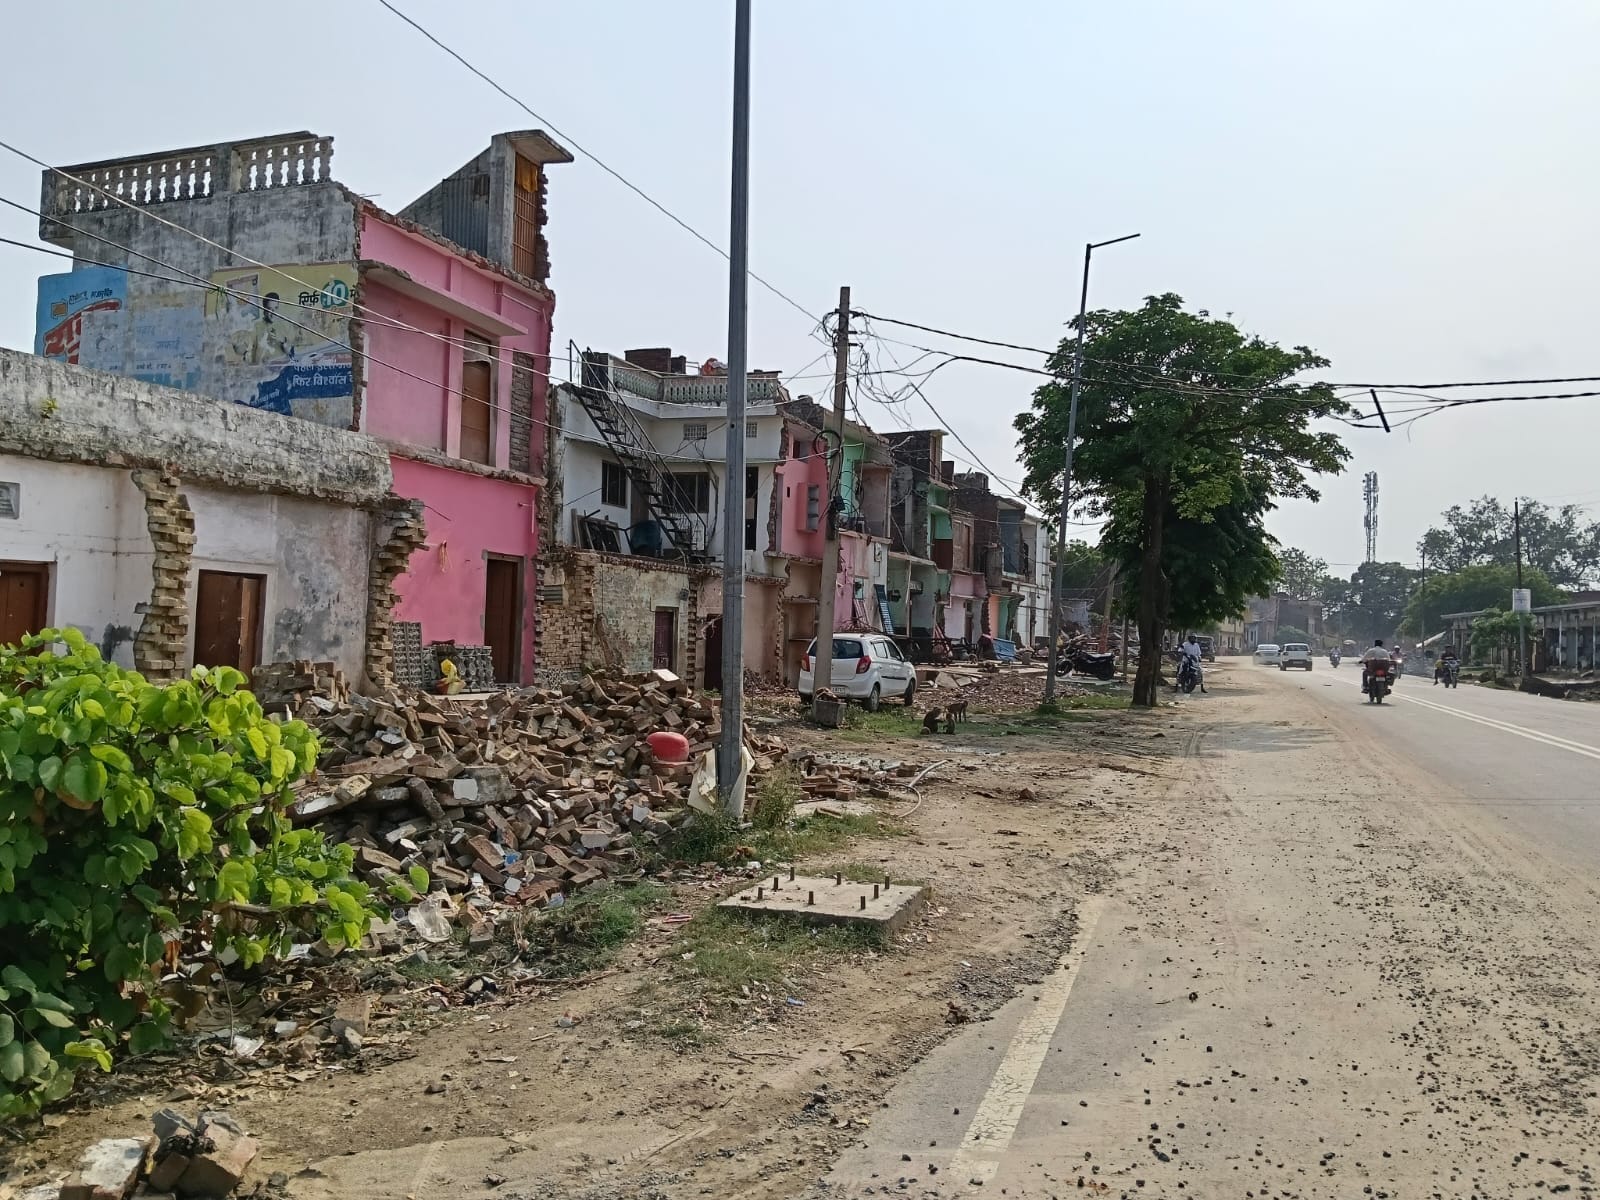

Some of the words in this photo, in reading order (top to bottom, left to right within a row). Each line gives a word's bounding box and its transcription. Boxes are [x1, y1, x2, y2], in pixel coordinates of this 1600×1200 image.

[299, 291, 319, 305] सिर्फ
[323, 281, 346, 306] 10
[293, 375, 311, 386] फिर
